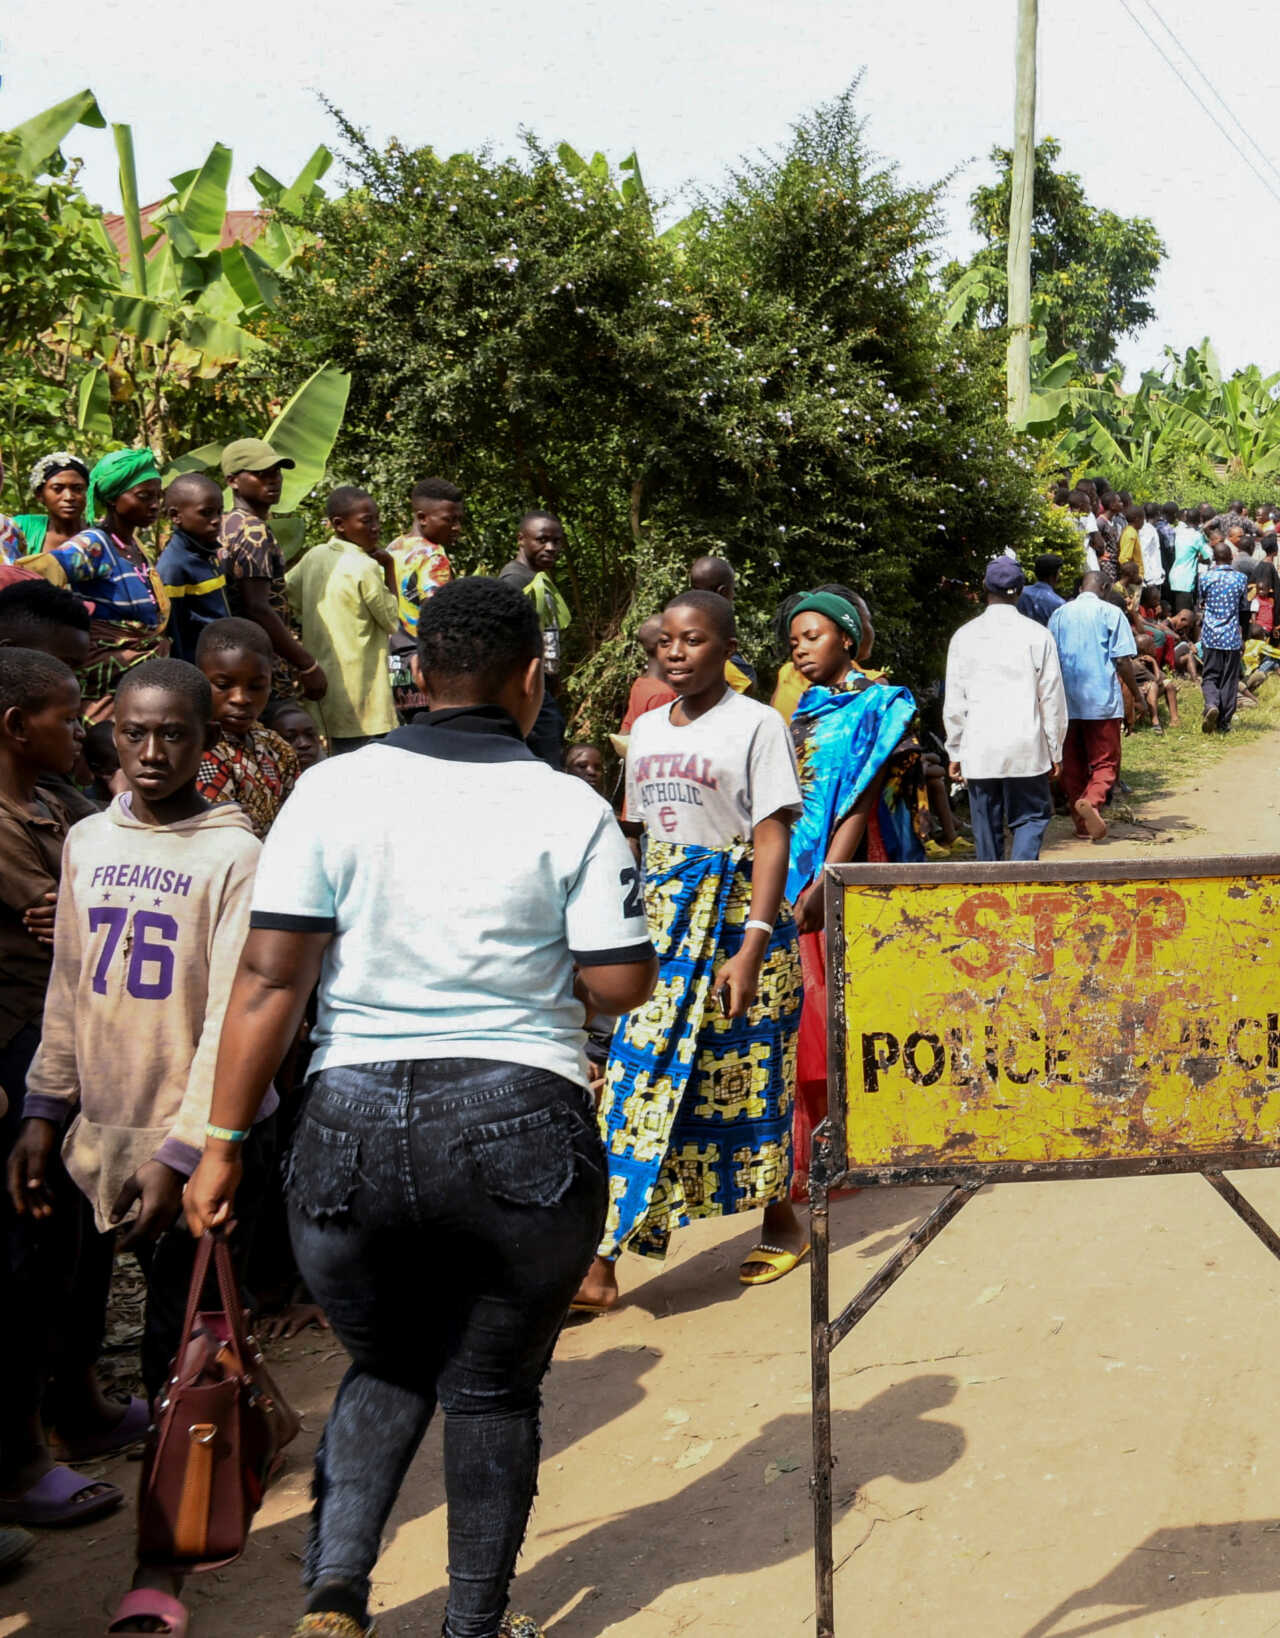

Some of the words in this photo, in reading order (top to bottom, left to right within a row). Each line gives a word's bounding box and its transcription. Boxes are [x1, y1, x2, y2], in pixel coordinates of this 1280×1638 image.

[641, 782, 703, 808] ATHOLIC
[91, 864, 192, 897] FREAKISH
[88, 906, 178, 1000] 76
[950, 887, 1187, 979] STOP
[861, 1025, 1075, 1093] POLICE
